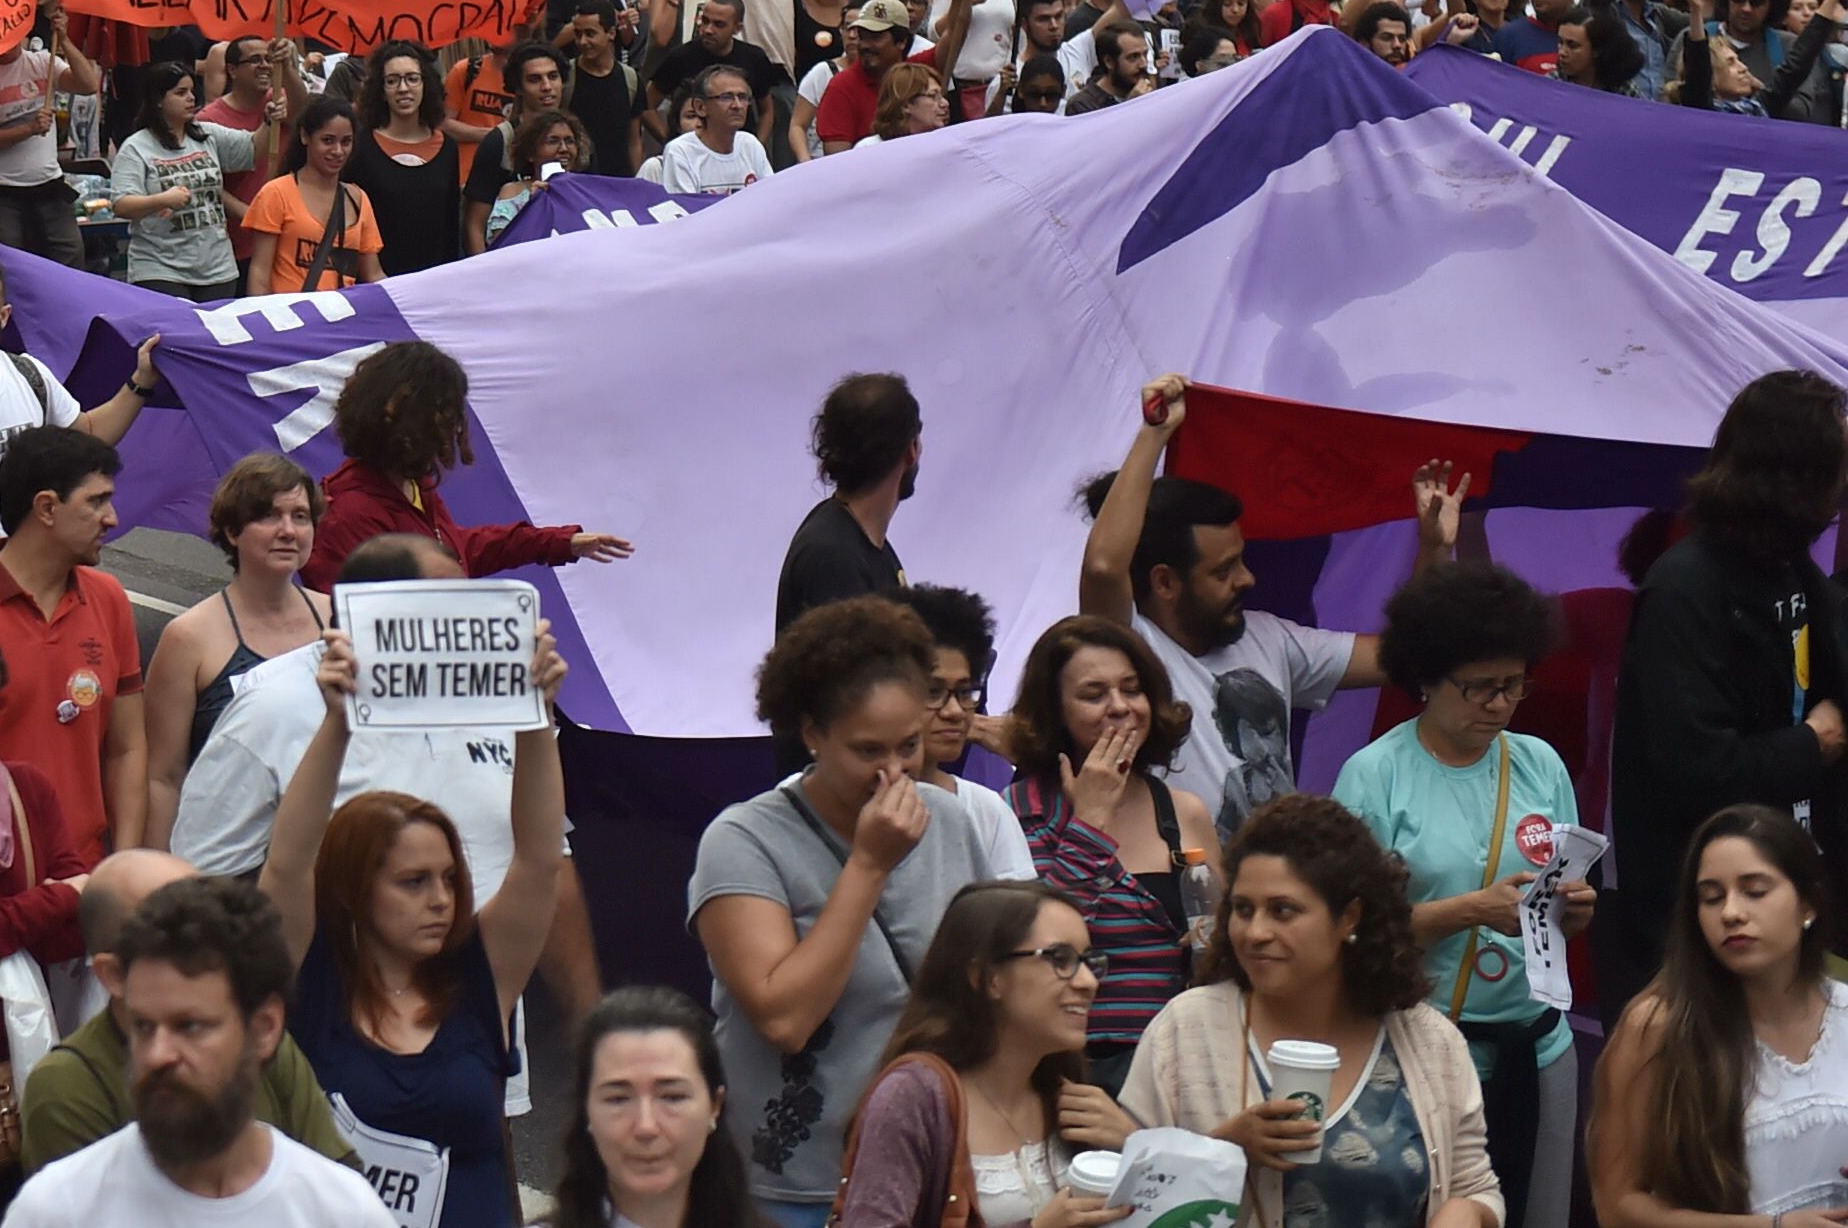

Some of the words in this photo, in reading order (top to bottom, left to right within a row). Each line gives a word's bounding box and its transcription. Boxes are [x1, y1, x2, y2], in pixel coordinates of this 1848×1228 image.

[475, 93, 502, 110] RUA
[375, 617, 521, 653] MULHERES
[372, 663, 427, 699] SEM
[436, 662, 527, 698] TEMER
[467, 739, 512, 767] NYC
[1526, 823, 1548, 835] FORA
